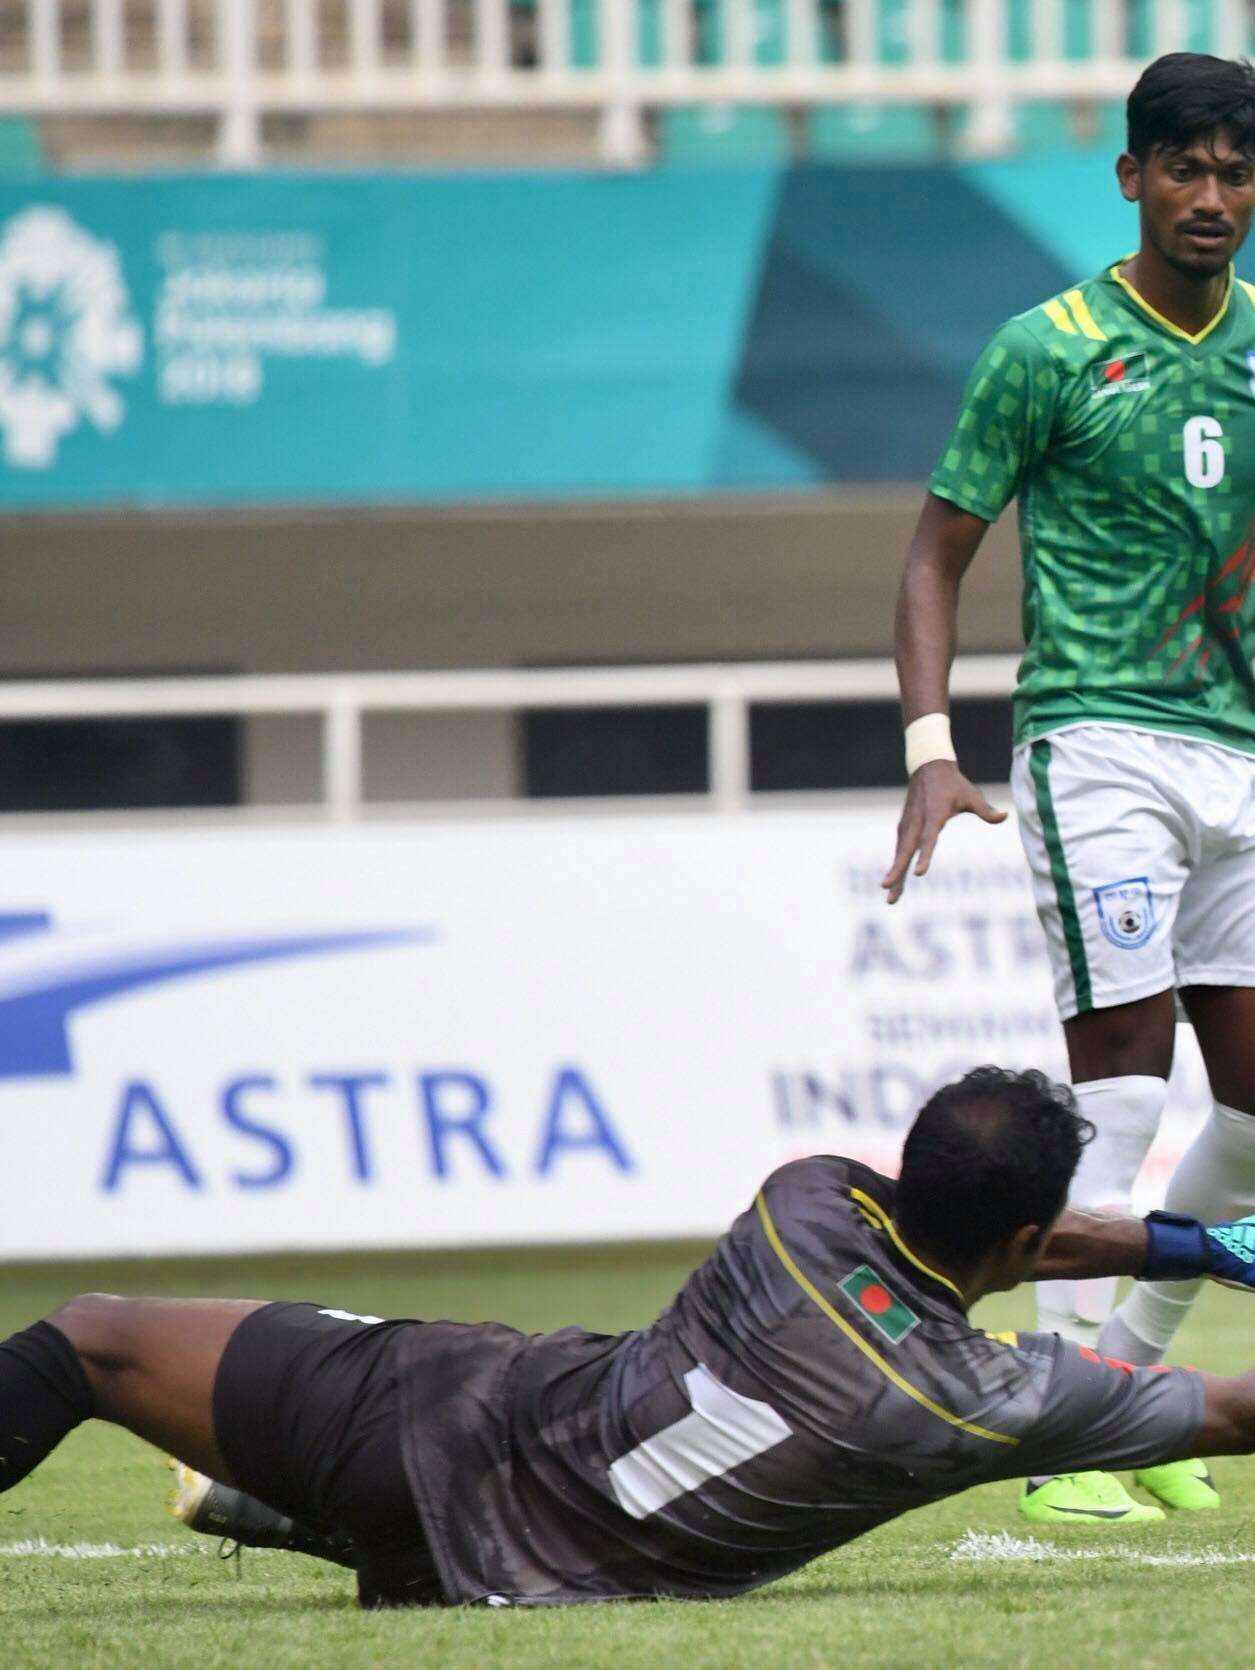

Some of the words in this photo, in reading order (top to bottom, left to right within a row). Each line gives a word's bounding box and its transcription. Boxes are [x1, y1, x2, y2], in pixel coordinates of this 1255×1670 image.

[1183, 415, 1225, 489] 6
[848, 914, 1048, 976] ASTR
[100, 1064, 637, 1194] ASTRA
[607, 1362, 793, 1520] 1
